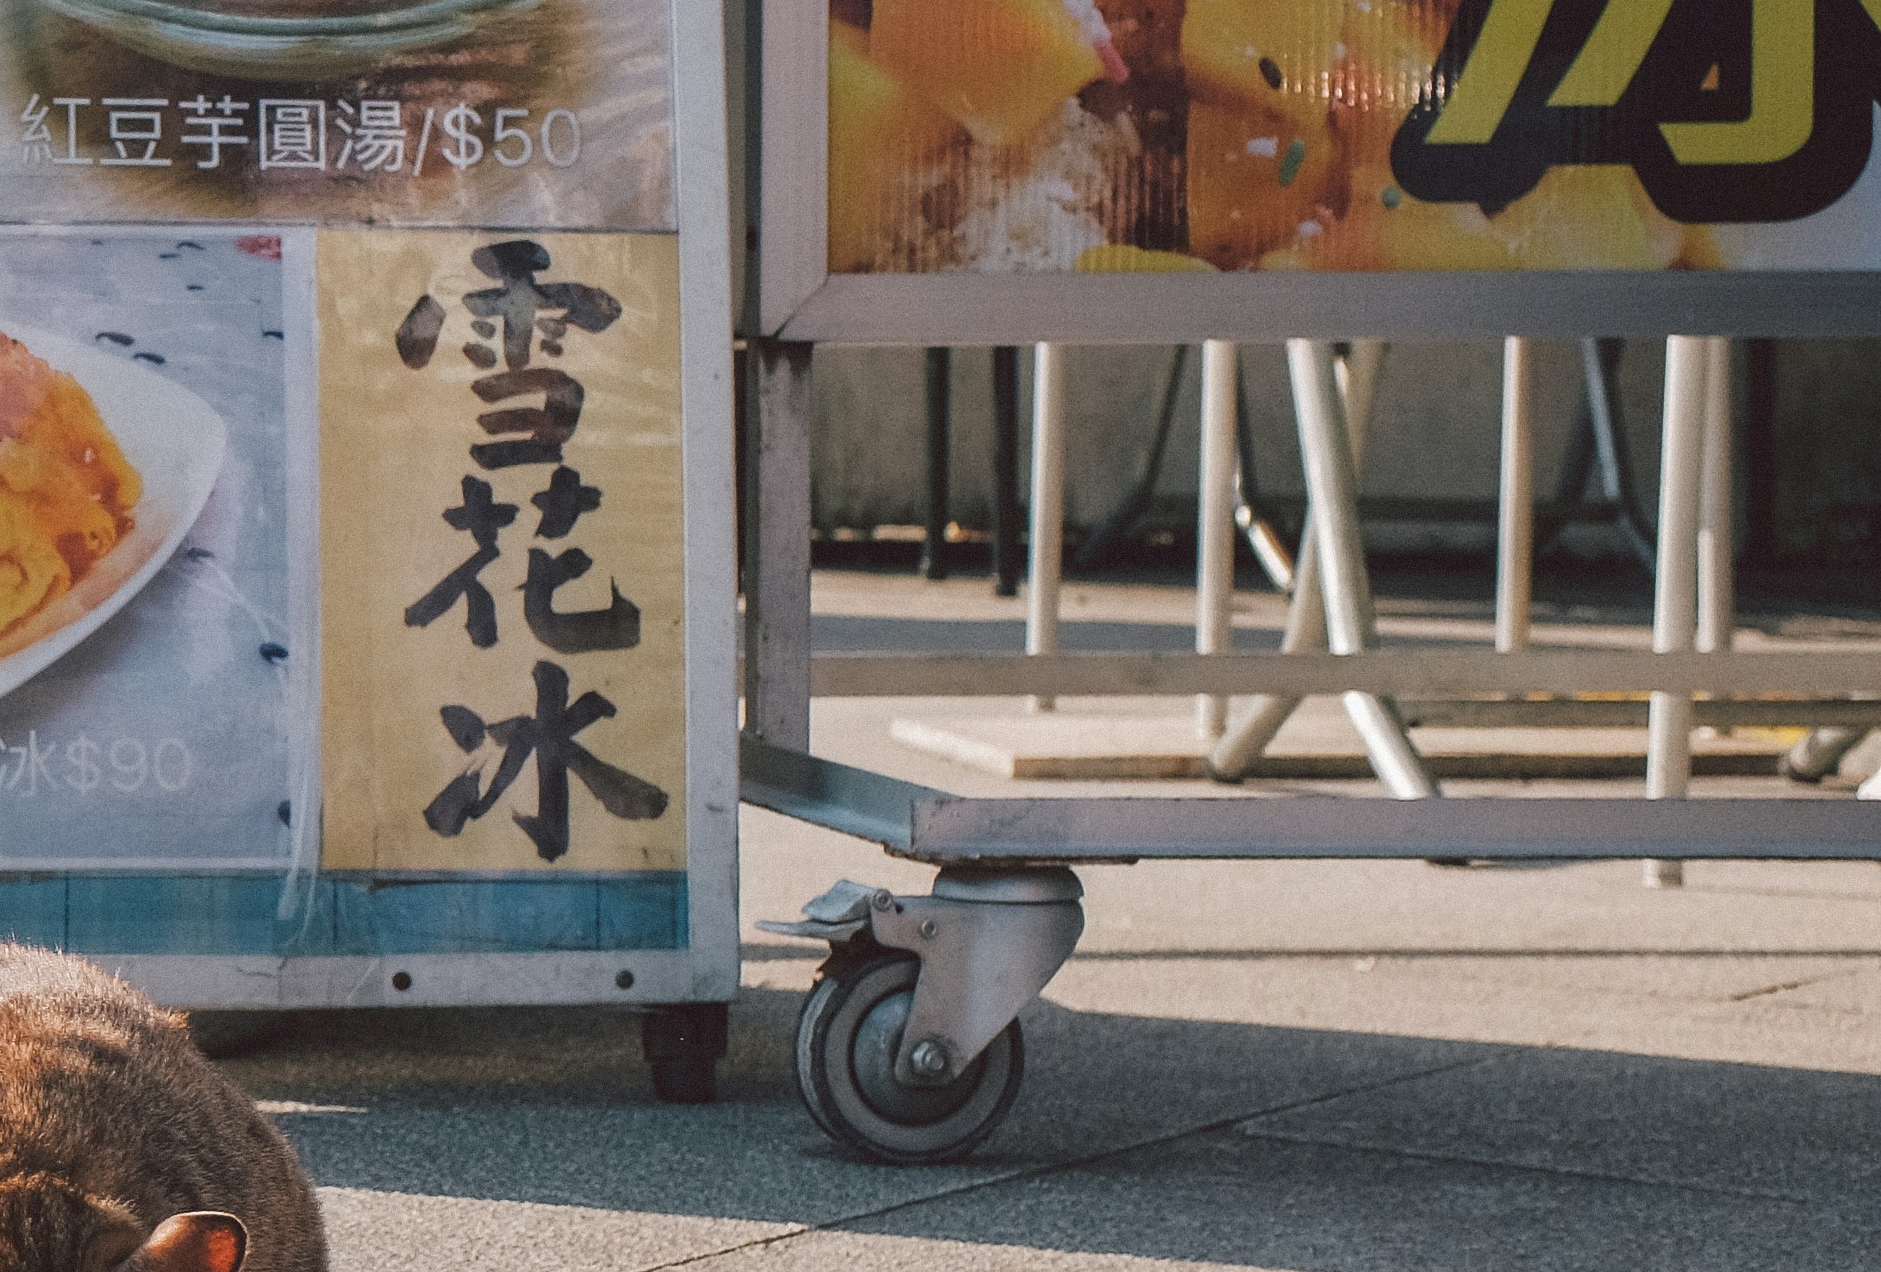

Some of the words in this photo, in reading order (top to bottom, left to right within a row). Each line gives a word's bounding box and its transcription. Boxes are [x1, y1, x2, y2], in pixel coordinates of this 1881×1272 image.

[21, 93, 582, 177] 紅豆芋圓湯/$50
[395, 239, 669, 863] 雪花冰
